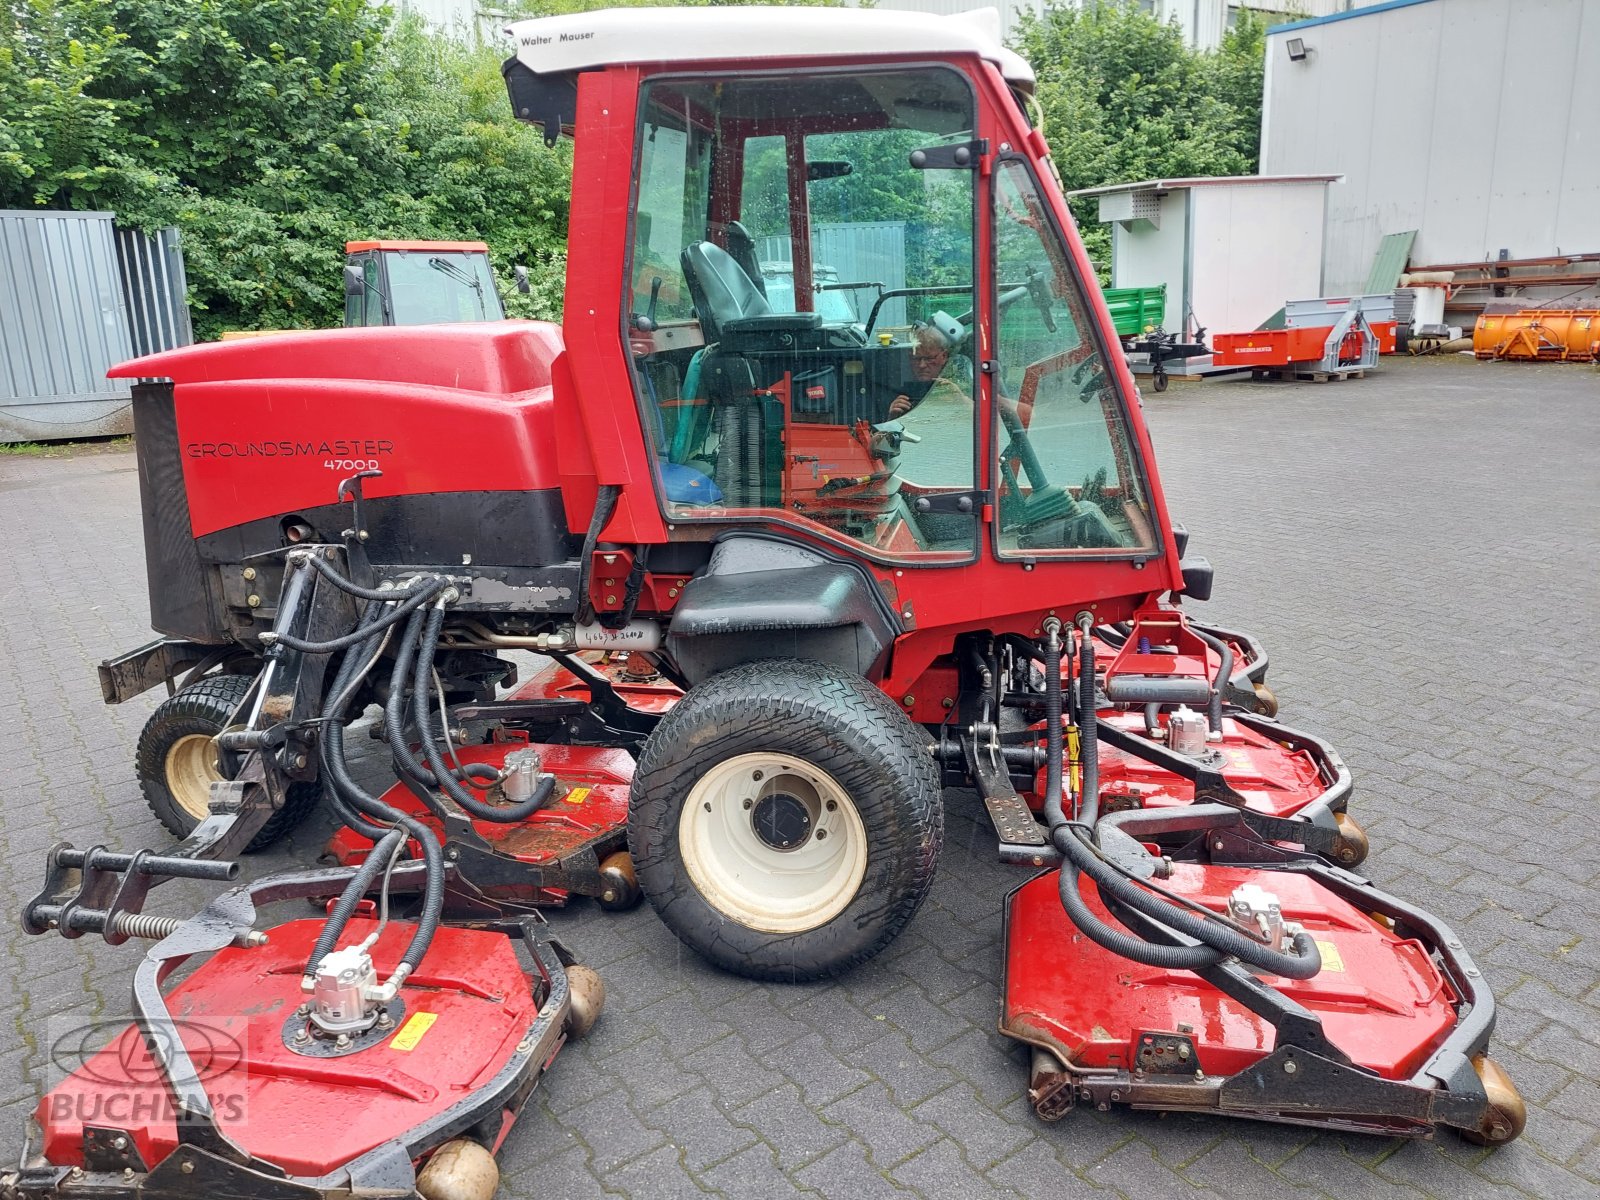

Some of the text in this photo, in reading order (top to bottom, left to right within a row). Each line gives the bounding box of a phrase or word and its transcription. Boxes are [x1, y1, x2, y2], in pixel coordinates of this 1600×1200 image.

[521, 32, 594, 46] Walter Mauser
[187, 440, 394, 457] GROUNDSMASTER
